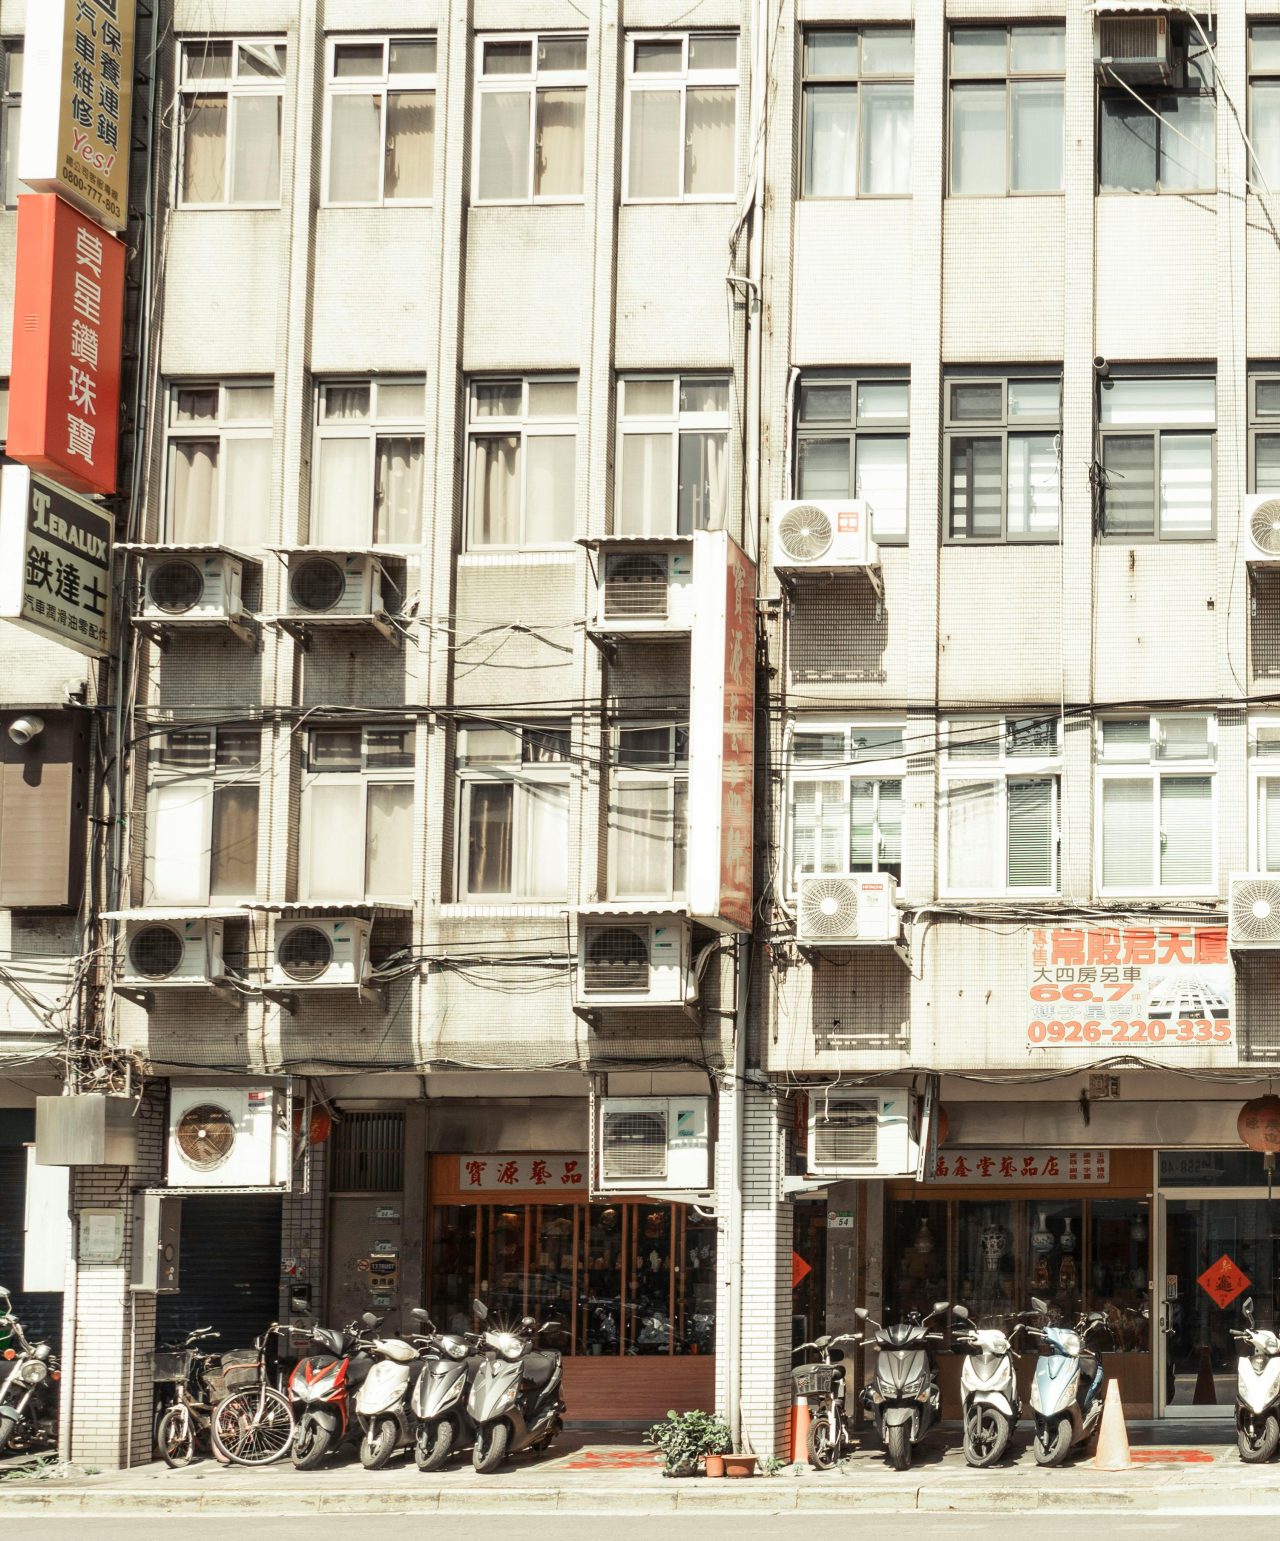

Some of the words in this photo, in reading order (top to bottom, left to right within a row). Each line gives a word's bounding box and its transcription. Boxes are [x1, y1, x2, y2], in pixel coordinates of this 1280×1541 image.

[71, 0, 97, 128] 汽車維修
[73, 129, 114, 175] Yes!
[33, 487, 109, 563] TERALUX
[1033, 966, 1142, 984] 大四房另車
[1029, 983, 1135, 1003] 66.7
[1027, 1020, 1232, 1043] 0926-220-335
[465, 1160, 600, 1186] 寶源藝品
